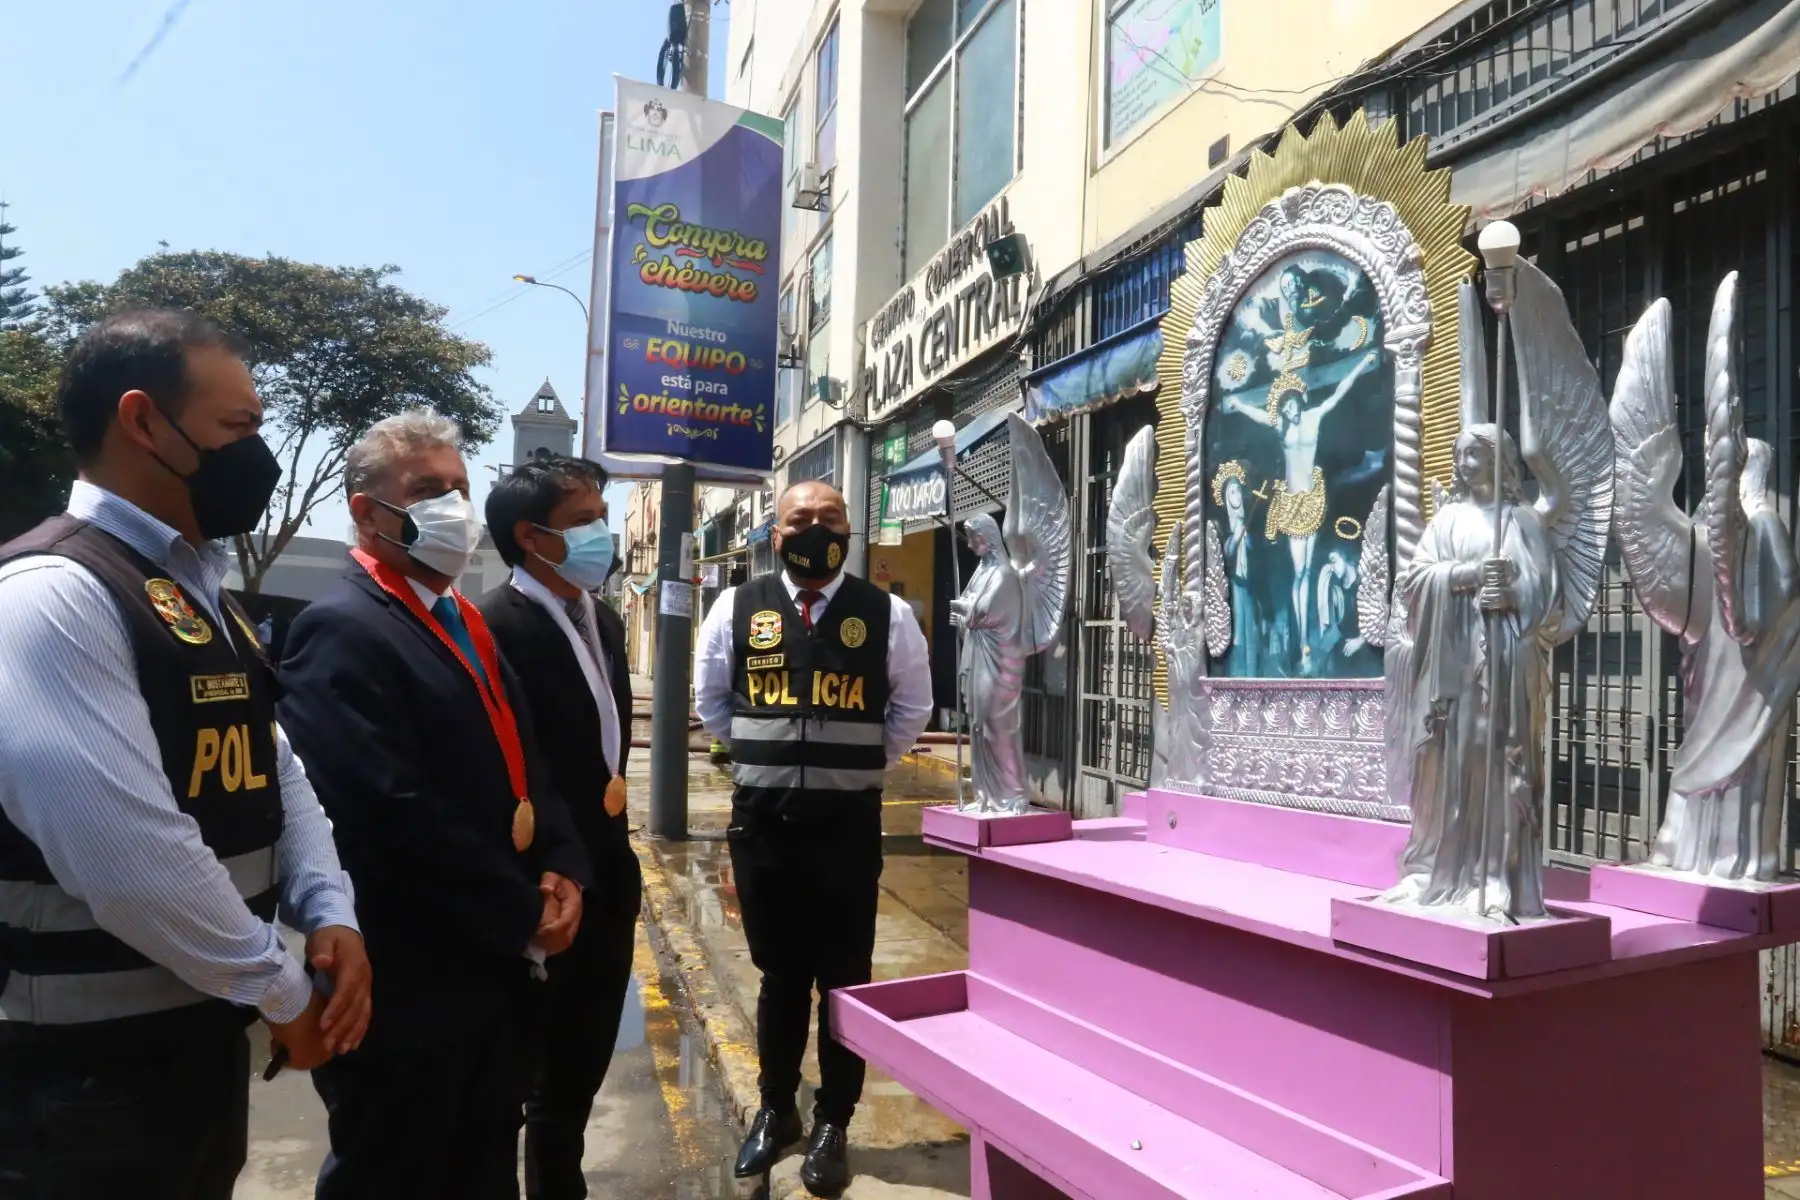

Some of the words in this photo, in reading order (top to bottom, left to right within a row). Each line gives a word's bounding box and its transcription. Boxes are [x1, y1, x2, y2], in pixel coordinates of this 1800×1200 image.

[626, 133, 683, 161] LIMA
[627, 203, 767, 262] Compra
[925, 196, 1015, 303] COMERCIAL
[640, 254, 758, 302] chévere
[667, 320, 727, 344] Nuestro
[863, 333, 914, 411] PLAZA
[918, 271, 1022, 381] CENTRAL
[645, 337, 747, 375] EQUIPO
[660, 374, 692, 390] está
[694, 380, 729, 396] para
[632, 389, 753, 427] orientarte
[747, 670, 798, 706] POL
